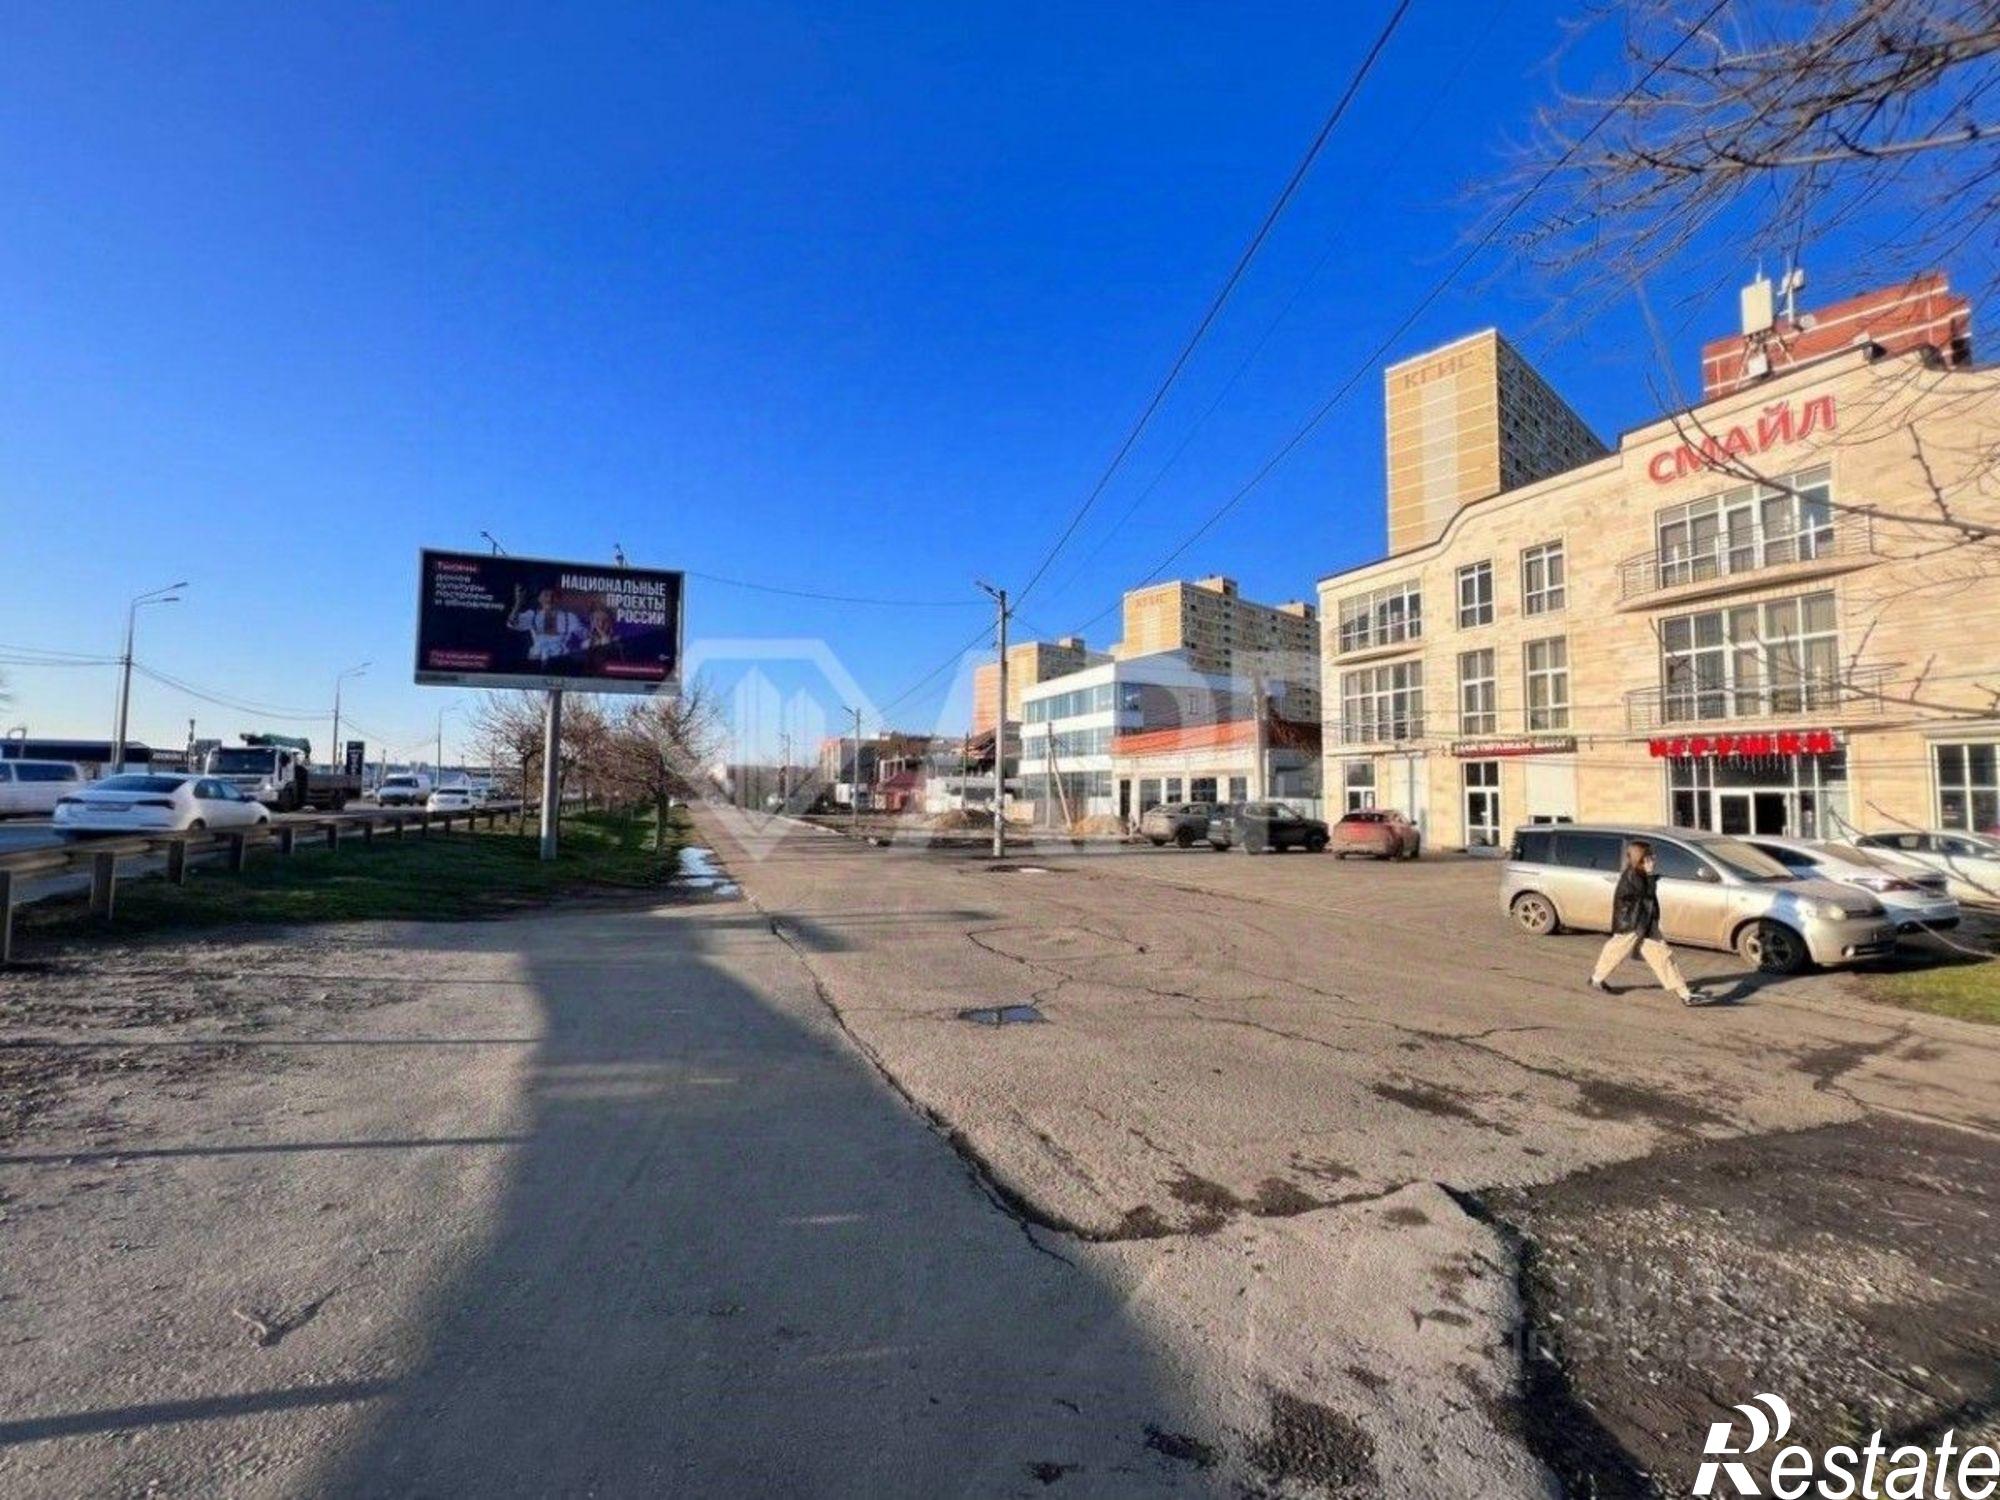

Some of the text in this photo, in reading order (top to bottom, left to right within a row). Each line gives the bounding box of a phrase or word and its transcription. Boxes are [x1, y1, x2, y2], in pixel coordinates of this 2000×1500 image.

[1648, 395, 1837, 485] СМАЙЛ
[561, 574, 667, 596] НАЦИОНАЛЬНЫЕ
[606, 593, 666, 611] ПРОЕКТЫ
[617, 609, 666, 625] РОССИИ
